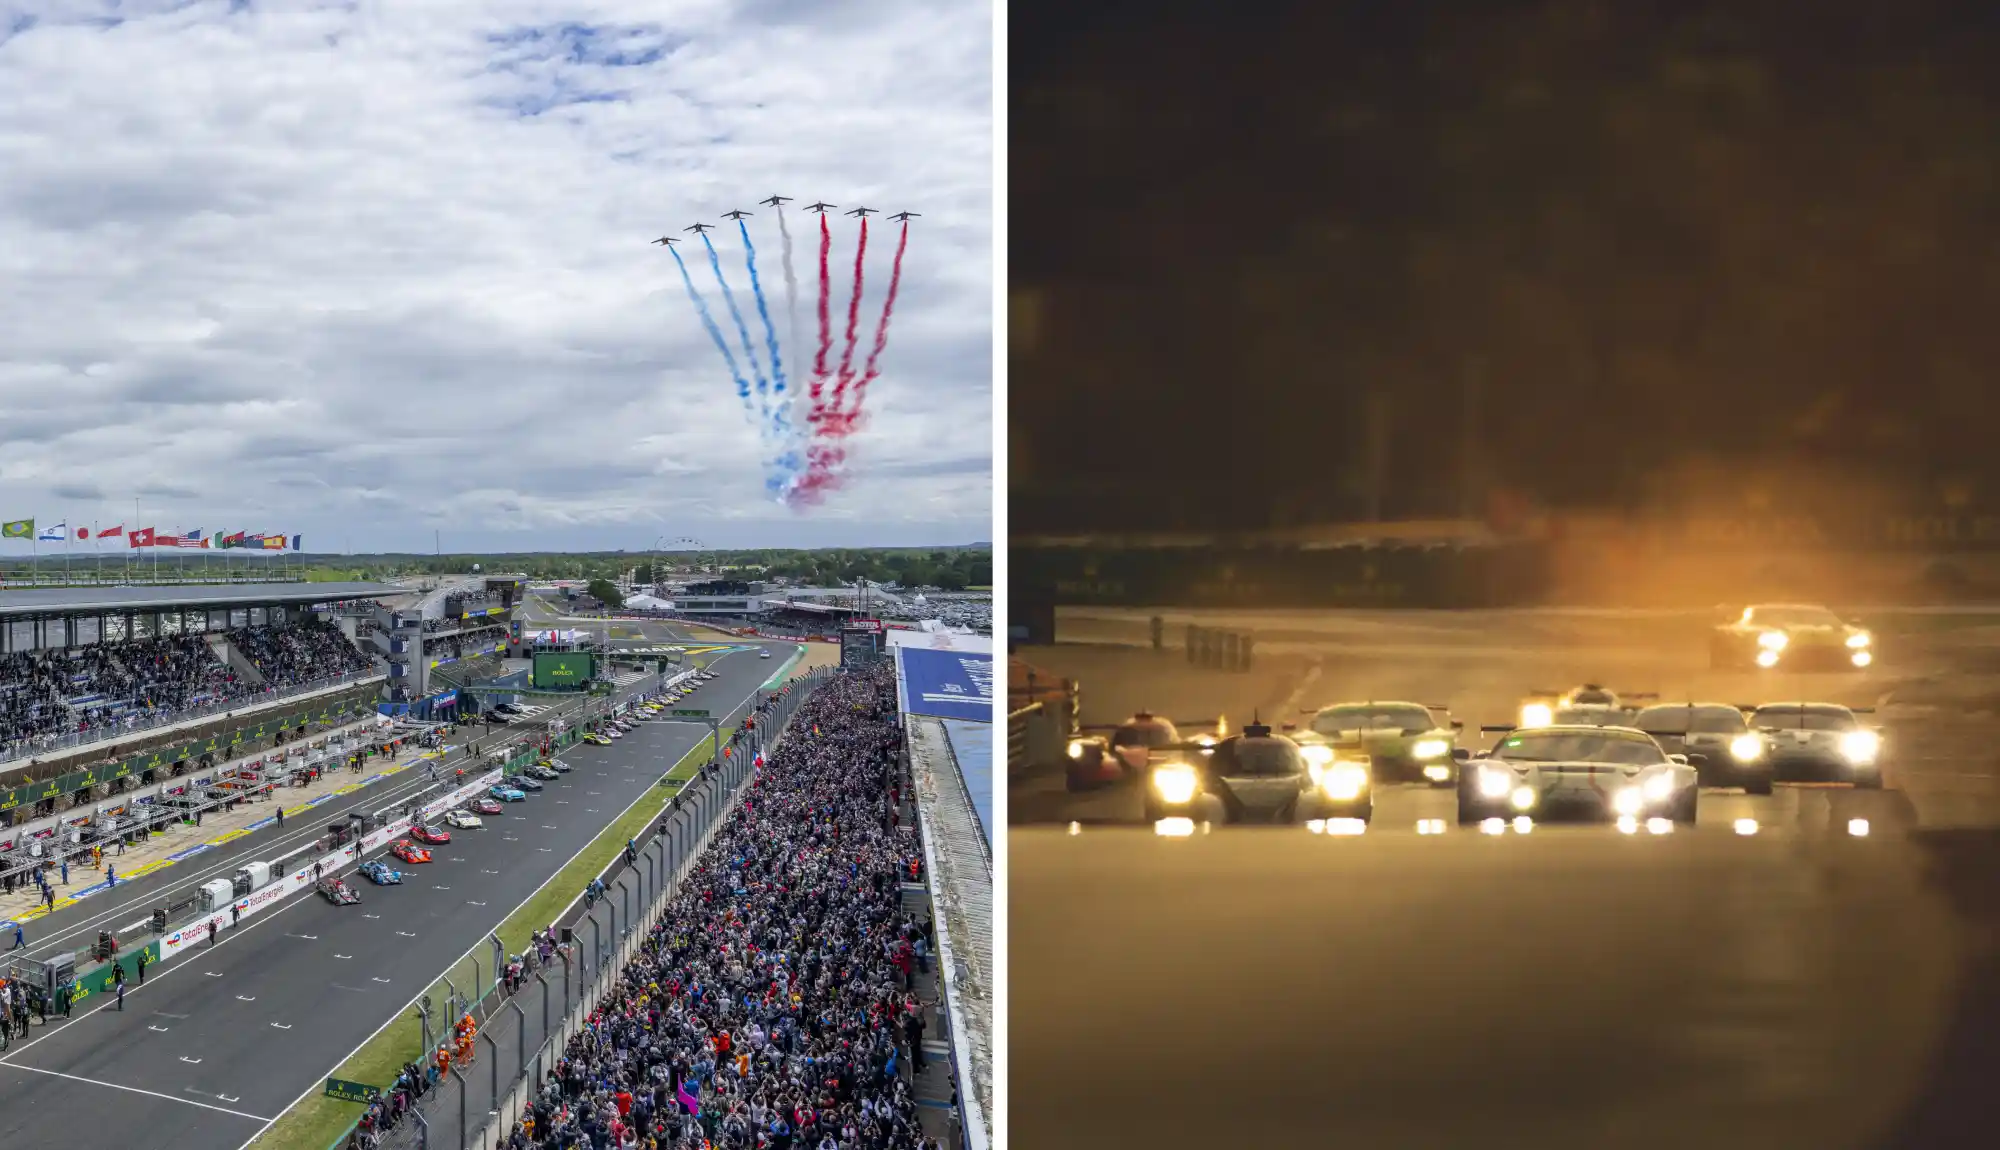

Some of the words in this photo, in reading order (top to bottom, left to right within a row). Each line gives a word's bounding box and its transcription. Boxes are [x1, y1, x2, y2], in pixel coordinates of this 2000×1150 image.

[853, 621, 879, 629] MOTUL
[42, 788, 60, 799] ROLEX
[1, 799, 20, 811] ROLEX
[249, 883, 284, 908] TotalEnergies
[328, 1089, 351, 1099] ROLEX
